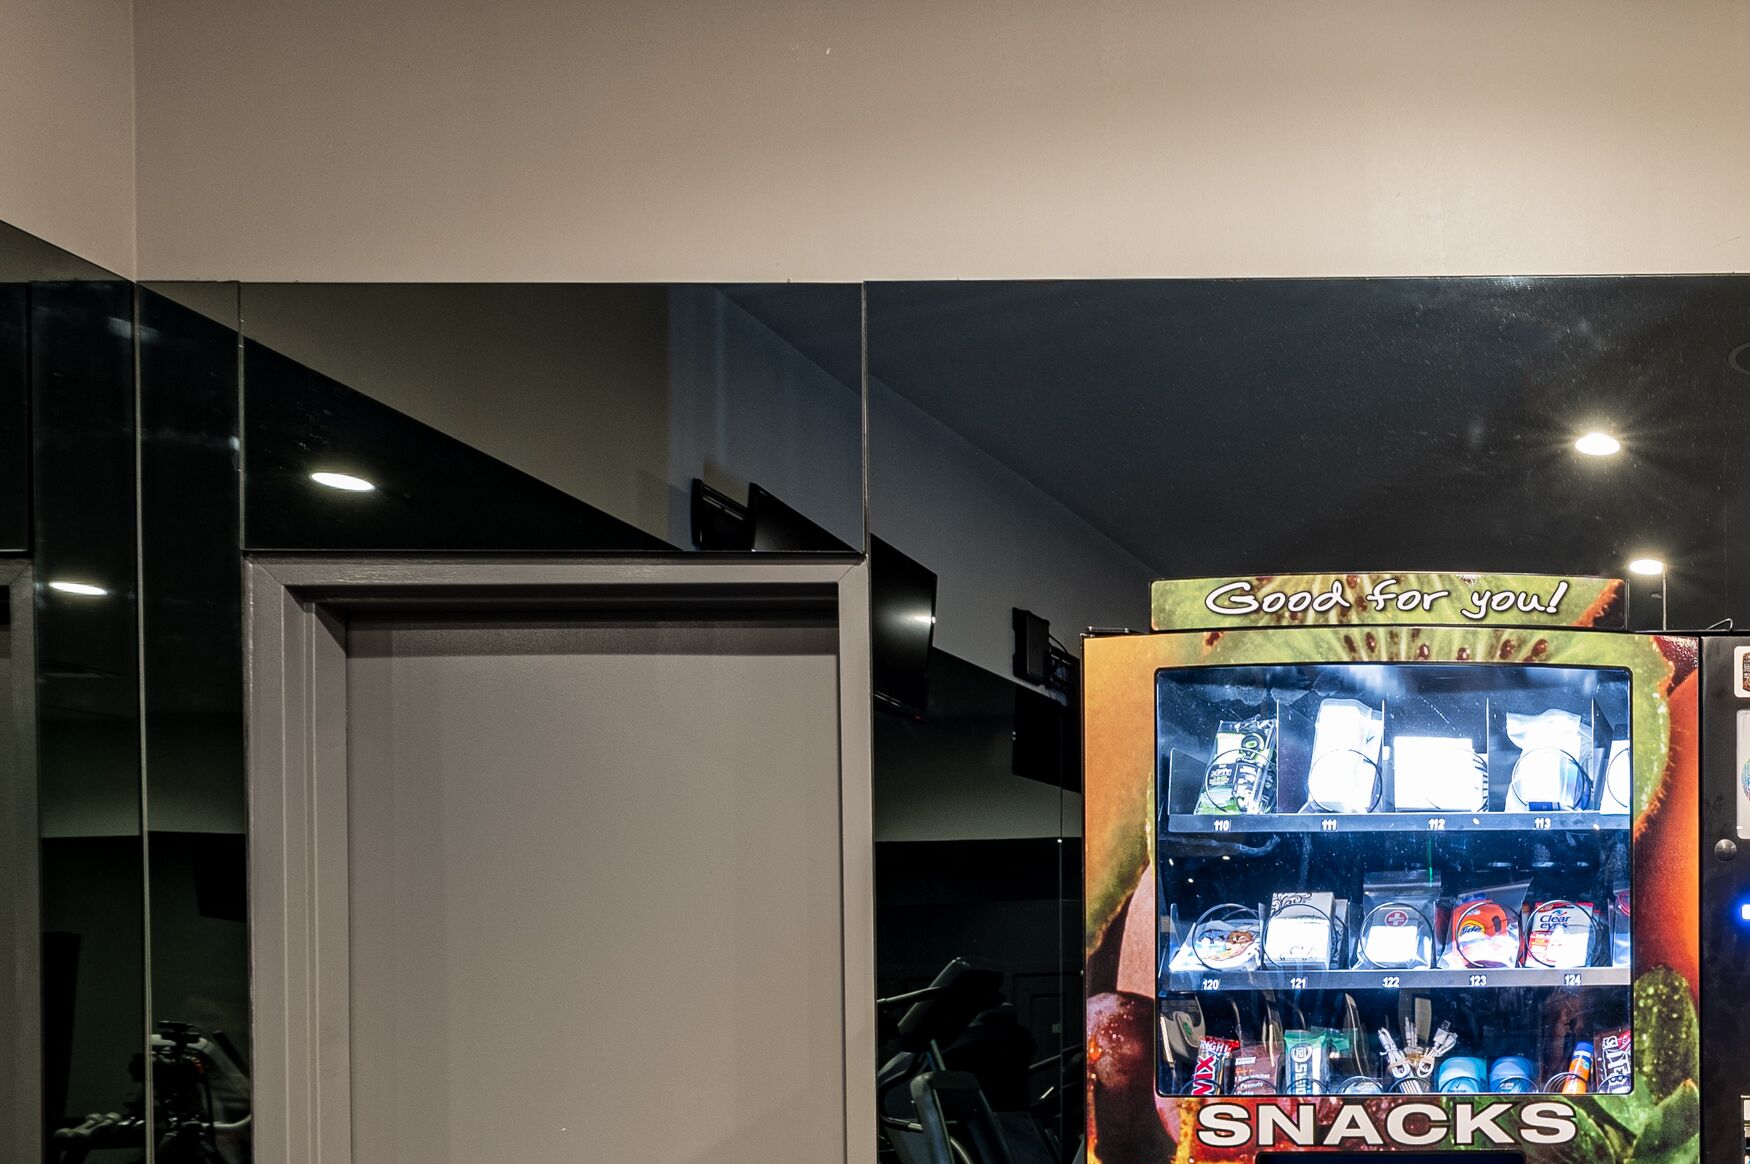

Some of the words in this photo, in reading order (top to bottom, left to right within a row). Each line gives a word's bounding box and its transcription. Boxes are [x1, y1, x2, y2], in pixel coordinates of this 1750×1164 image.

[1204, 581, 1351, 614] Good
[1366, 579, 1449, 612] for
[1461, 581, 1569, 619] you!
[1213, 819, 1228, 831] 110
[1321, 819, 1337, 831] 111
[1428, 818, 1445, 830] 112
[1534, 818, 1551, 830] 113
[1540, 914, 1571, 923] Clear
[1203, 979, 1219, 990] 120
[1290, 978, 1306, 989] 121
[1382, 977, 1400, 989] 122
[1470, 975, 1487, 986] 123
[1564, 974, 1581, 985] 124
[1197, 1102, 1578, 1147] SNACKS
